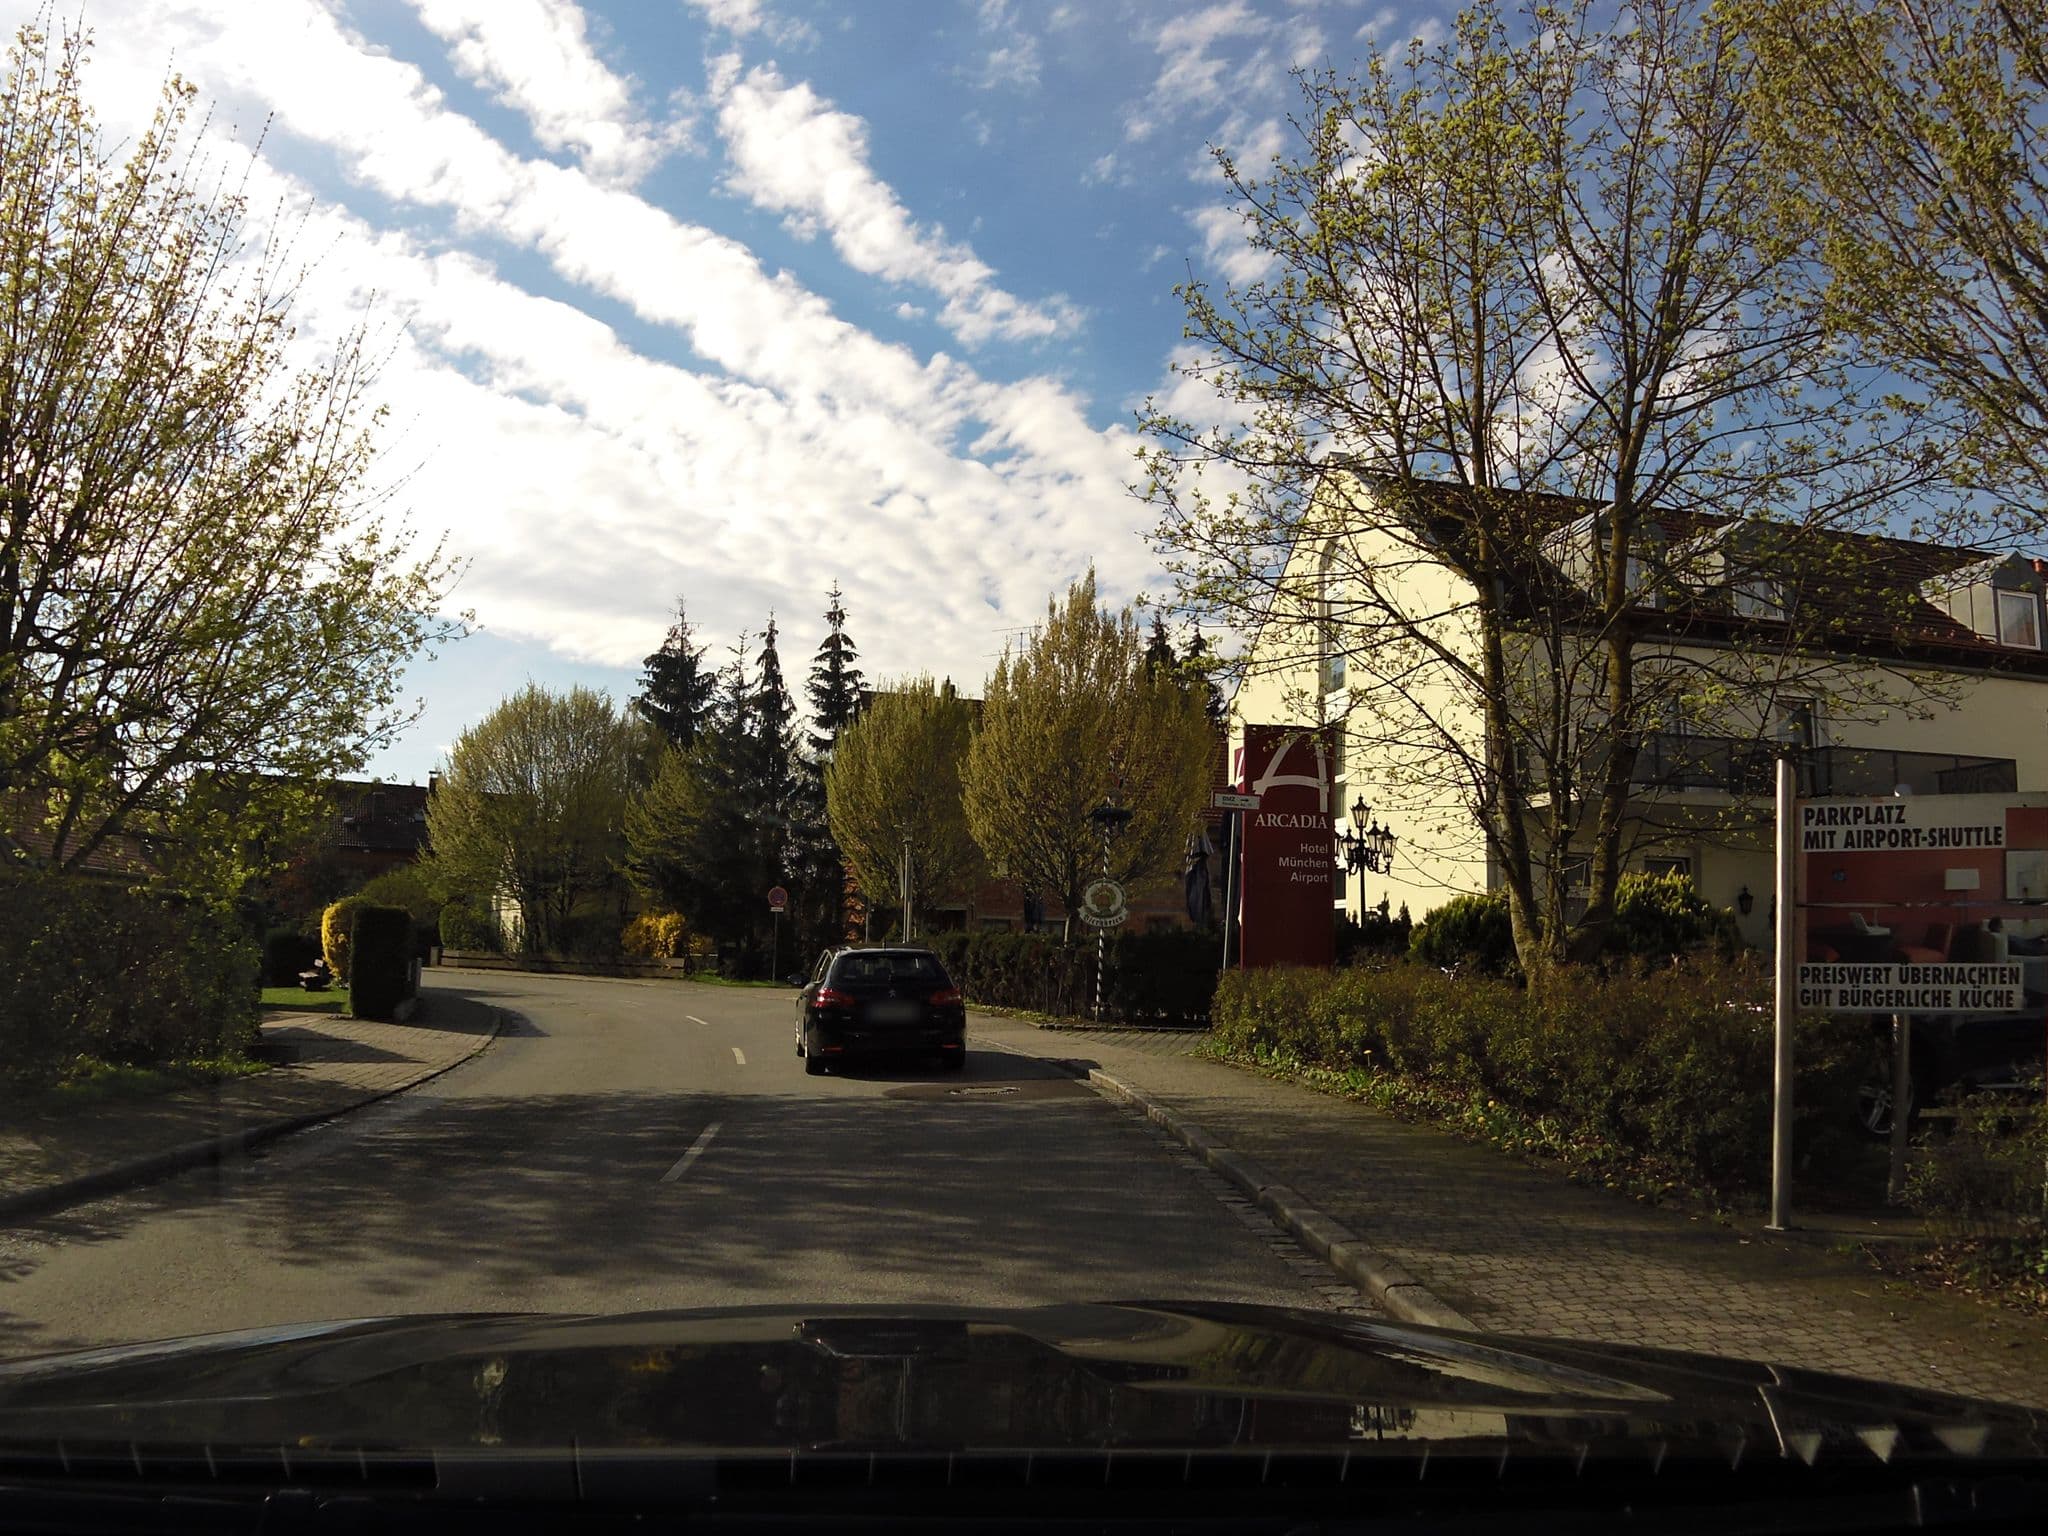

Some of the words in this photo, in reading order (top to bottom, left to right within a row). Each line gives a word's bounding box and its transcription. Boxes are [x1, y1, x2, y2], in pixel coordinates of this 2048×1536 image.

[1255, 813, 1328, 829] ARCADIA
[1803, 804, 1907, 826] PARKPLATZ
[1803, 829, 1837, 849] MIT
[1843, 826, 2003, 849] AIRPORT-SHUTTLE
[1300, 842, 1328, 854] Hotel
[1278, 856, 1328, 868] München
[1290, 871, 1328, 884] Airport
[1799, 966, 1892, 985] PREISWERT
[1899, 962, 2020, 985] ÜBERNACHTEN
[1799, 988, 1832, 1007] GUT
[1838, 985, 1952, 1008] BÜRGERLICHE
[1959, 985, 2015, 1008] KÜCHE
